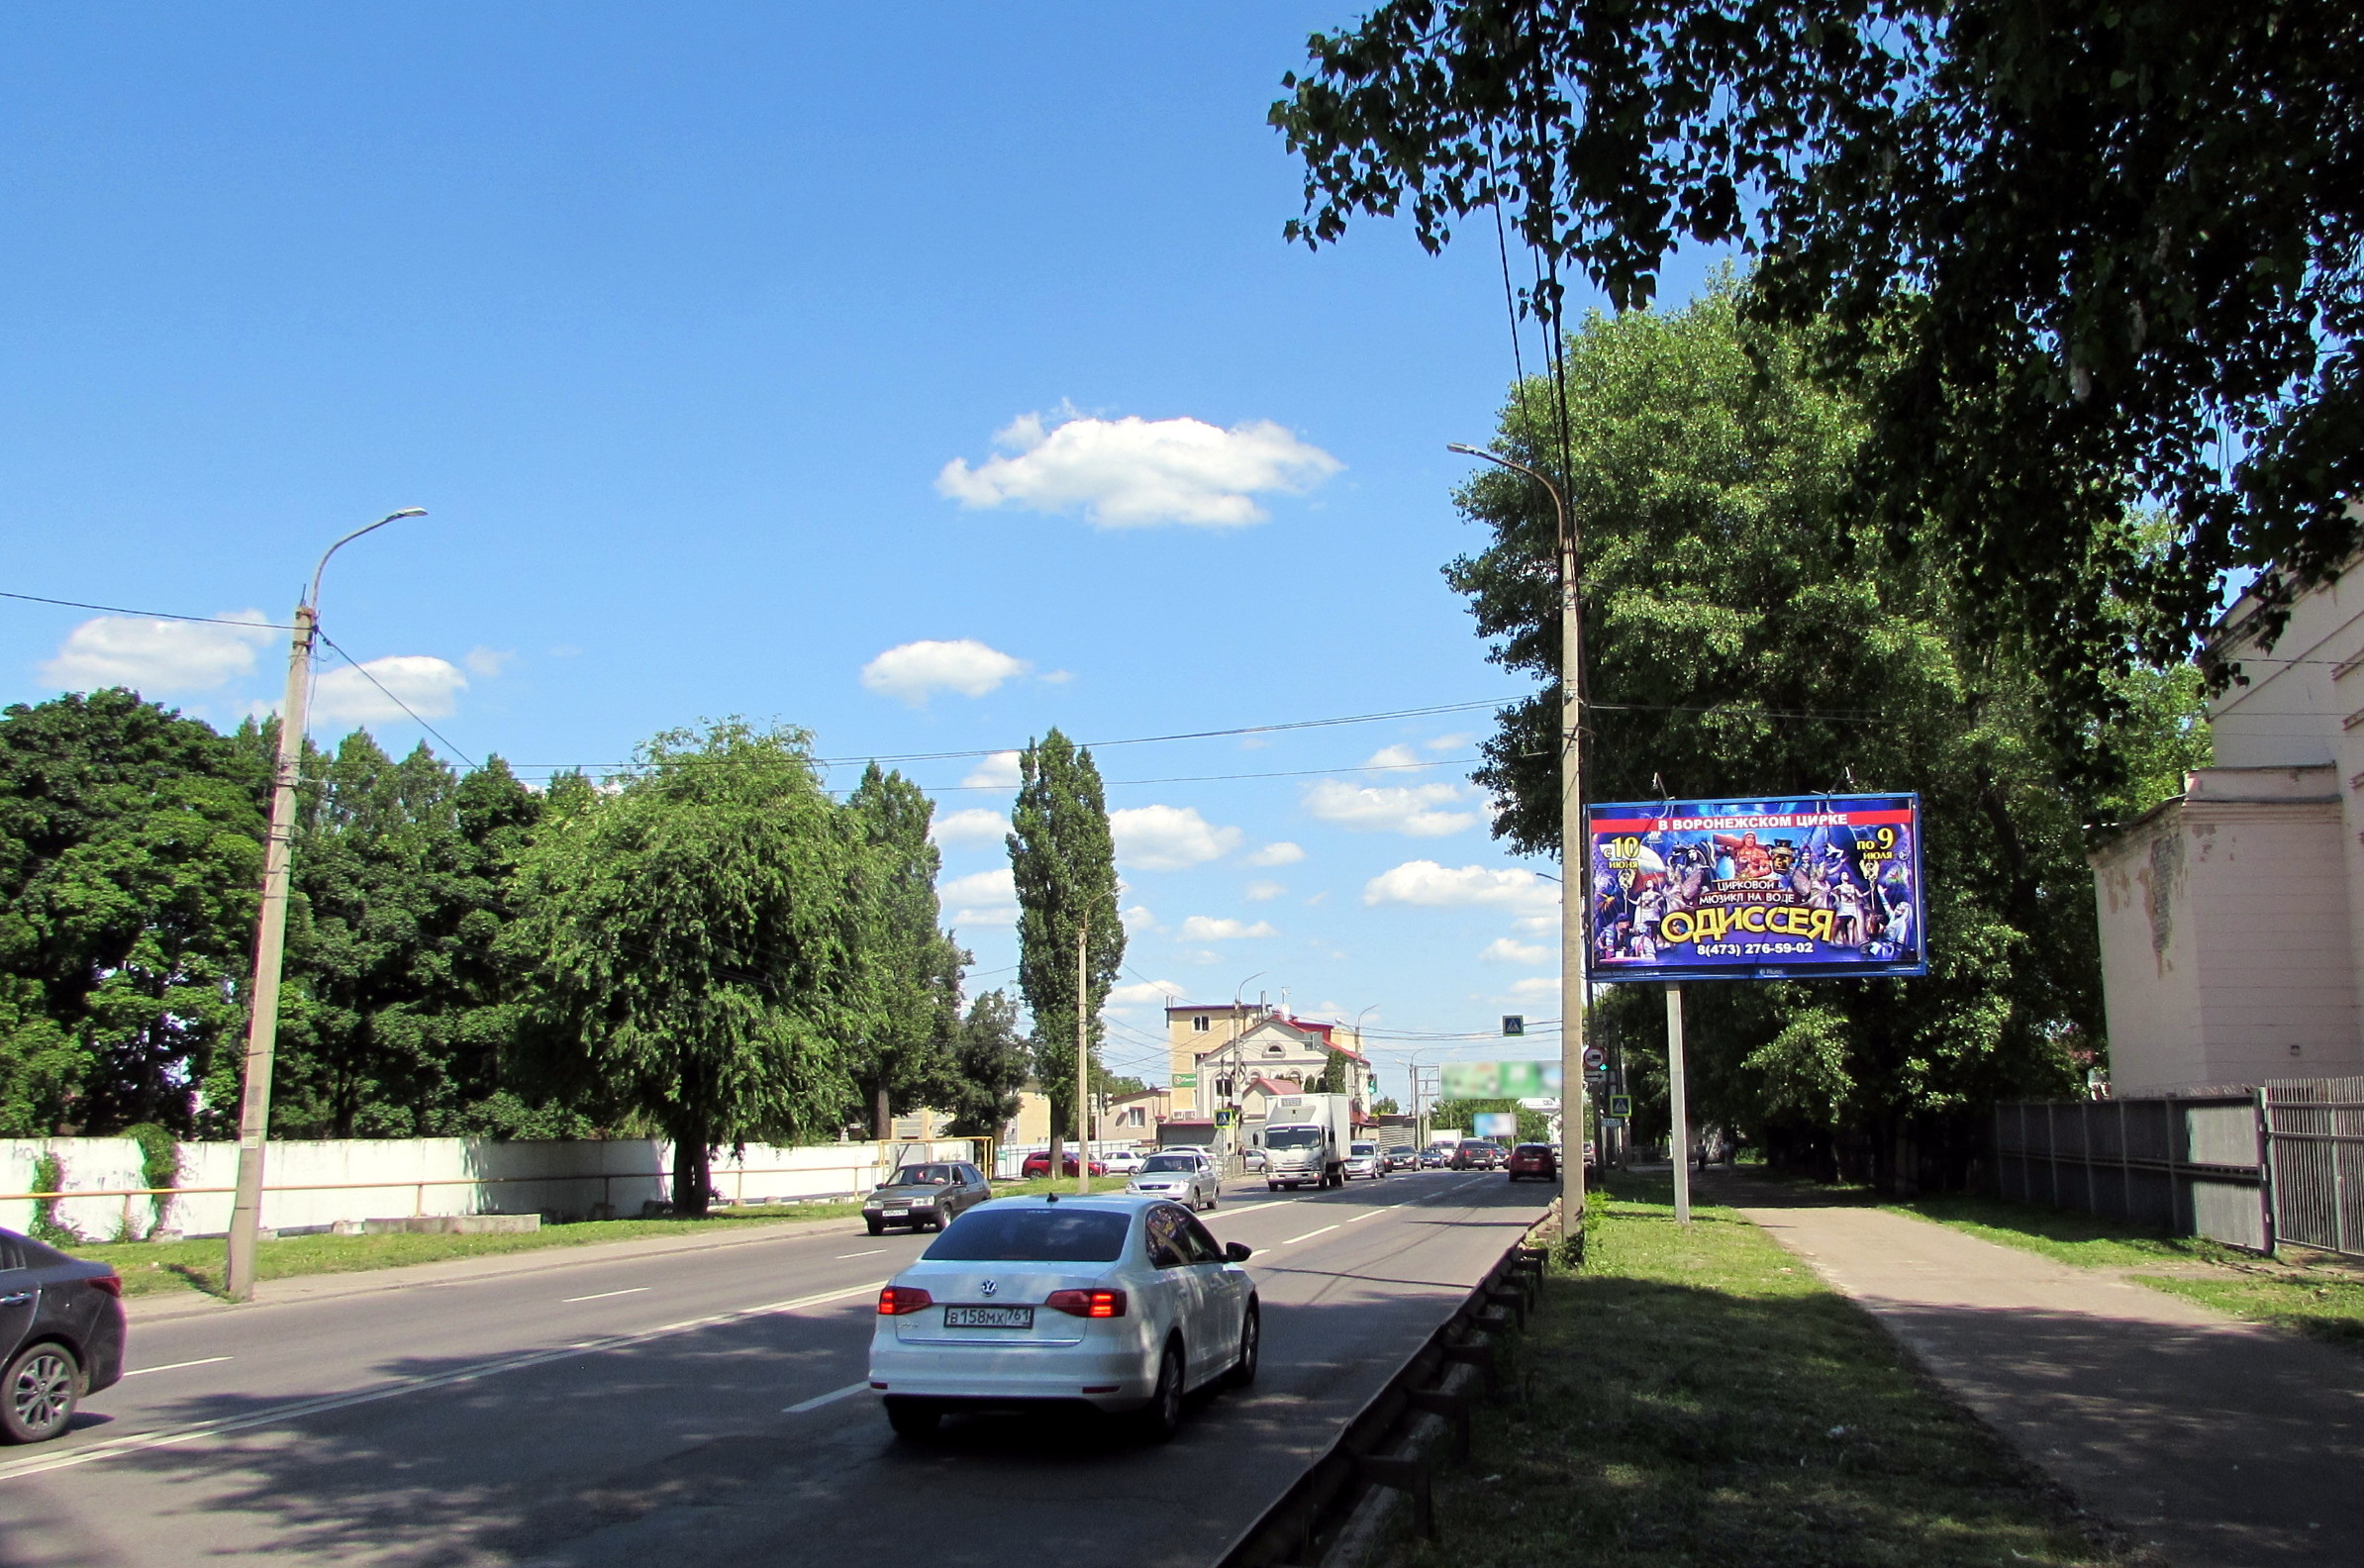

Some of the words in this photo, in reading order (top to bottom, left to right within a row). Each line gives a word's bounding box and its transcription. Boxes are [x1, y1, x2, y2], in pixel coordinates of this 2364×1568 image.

[1658, 820, 1668, 831] В
[1673, 816, 1791, 831] ВОРОНЕЖСКОМ
[1796, 814, 1847, 828] ЦИРКЕ
[1612, 836, 1639, 858] 10
[1877, 828, 1894, 849] 9
[1718, 880, 1775, 892] ЦИРКОВОЙ
[1699, 894, 1743, 905] МЮЗИКЛ
[1747, 894, 1761, 903] НА
[1766, 893, 1795, 904] ВОДЕ
[1660, 906, 1834, 943] ОДИССЕЯ
[1697, 944, 1741, 957] 8(473)
[1744, 942, 1814, 955] 276-59-02
